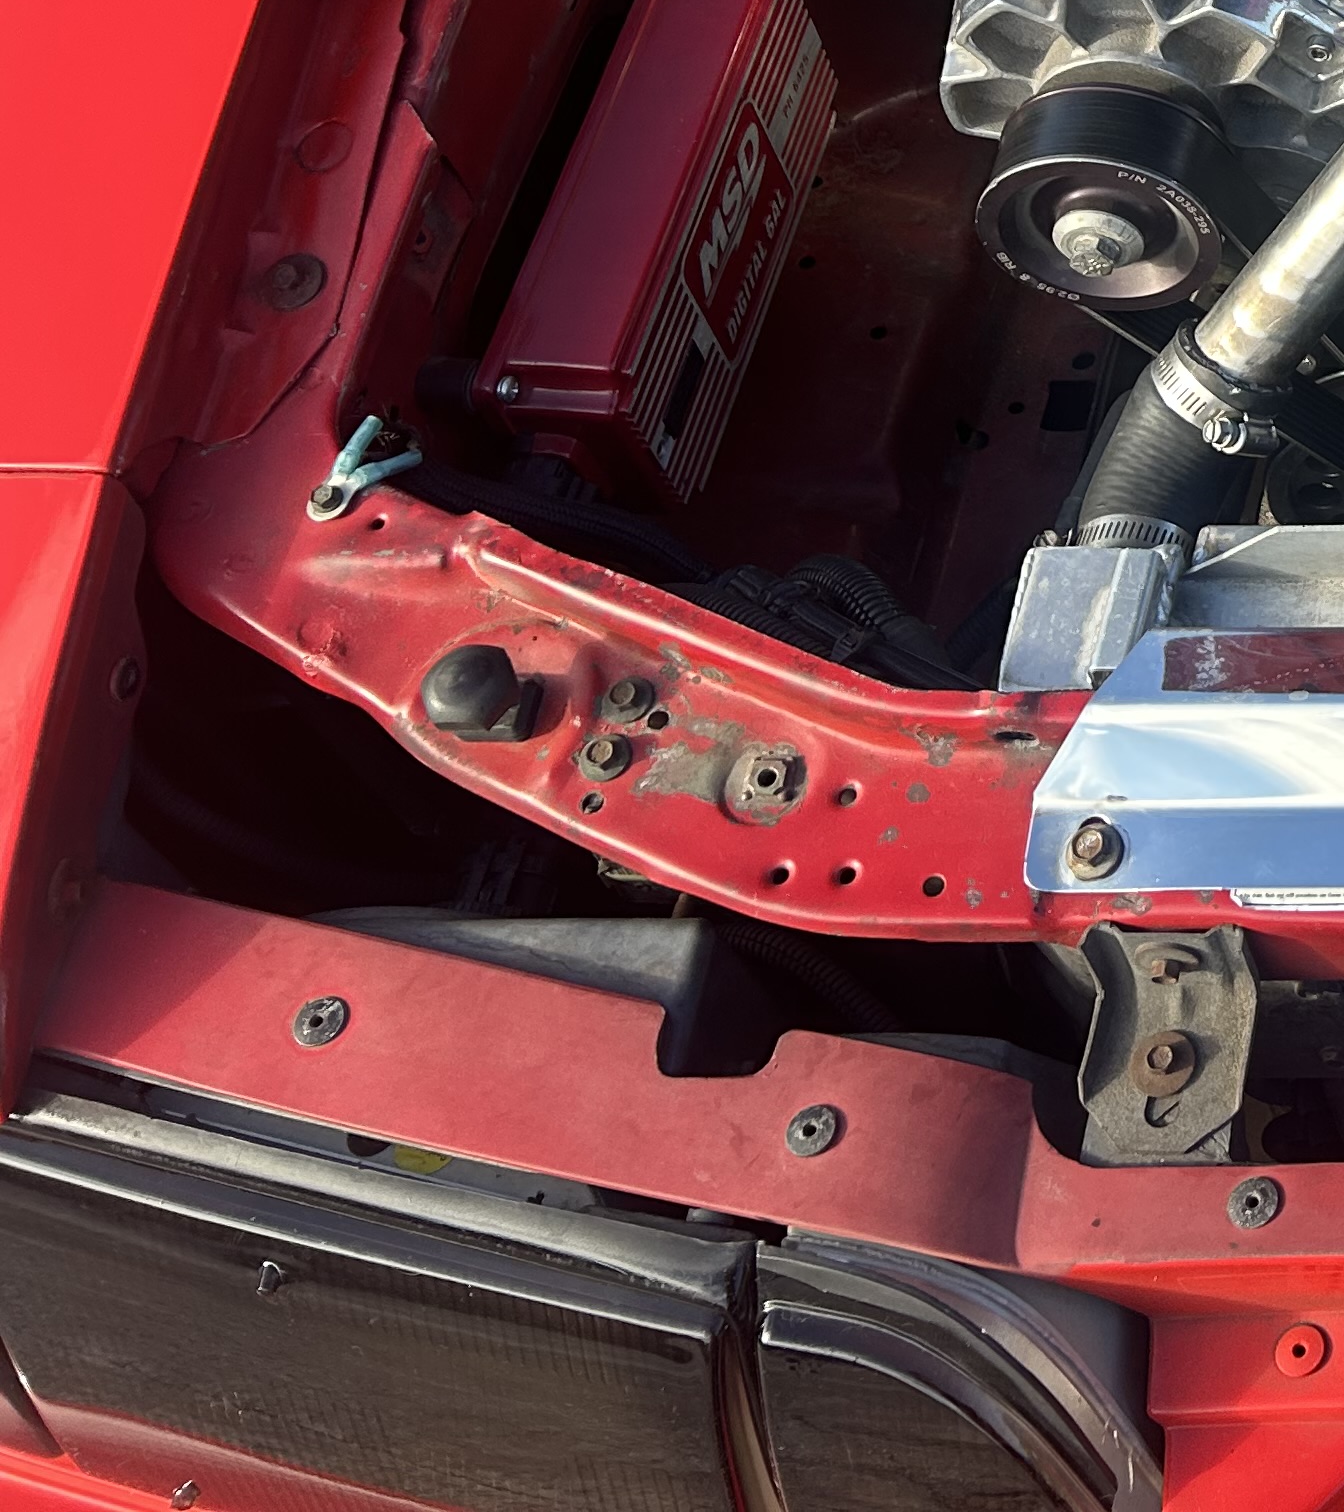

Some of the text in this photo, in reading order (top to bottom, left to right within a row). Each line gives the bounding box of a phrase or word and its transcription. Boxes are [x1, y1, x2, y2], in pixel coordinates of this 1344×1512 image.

[699, 122, 760, 298] MSD
[1118, 171, 1147, 184] P/N
[726, 189, 787, 345] DIGITAL 6AL
